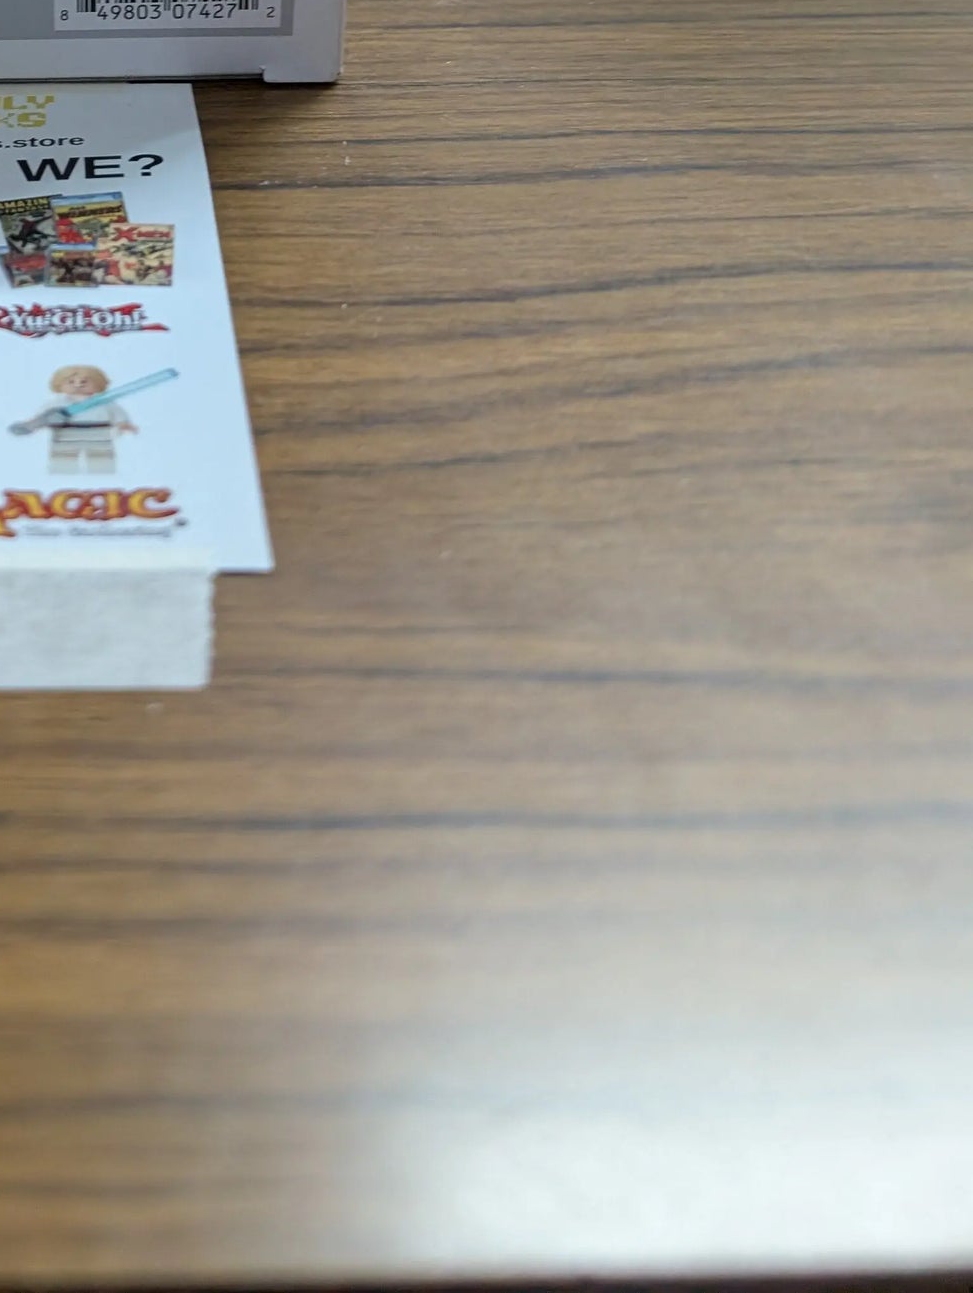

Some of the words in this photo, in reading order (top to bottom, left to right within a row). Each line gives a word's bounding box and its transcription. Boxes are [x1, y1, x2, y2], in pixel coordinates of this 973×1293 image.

[60, 10, 69, 21] 8
[97, 4, 162, 20] 49803
[173, 3, 237, 19] 07427
[266, 6, 275, 18] 2
[16, 154, 165, 182] WE?
